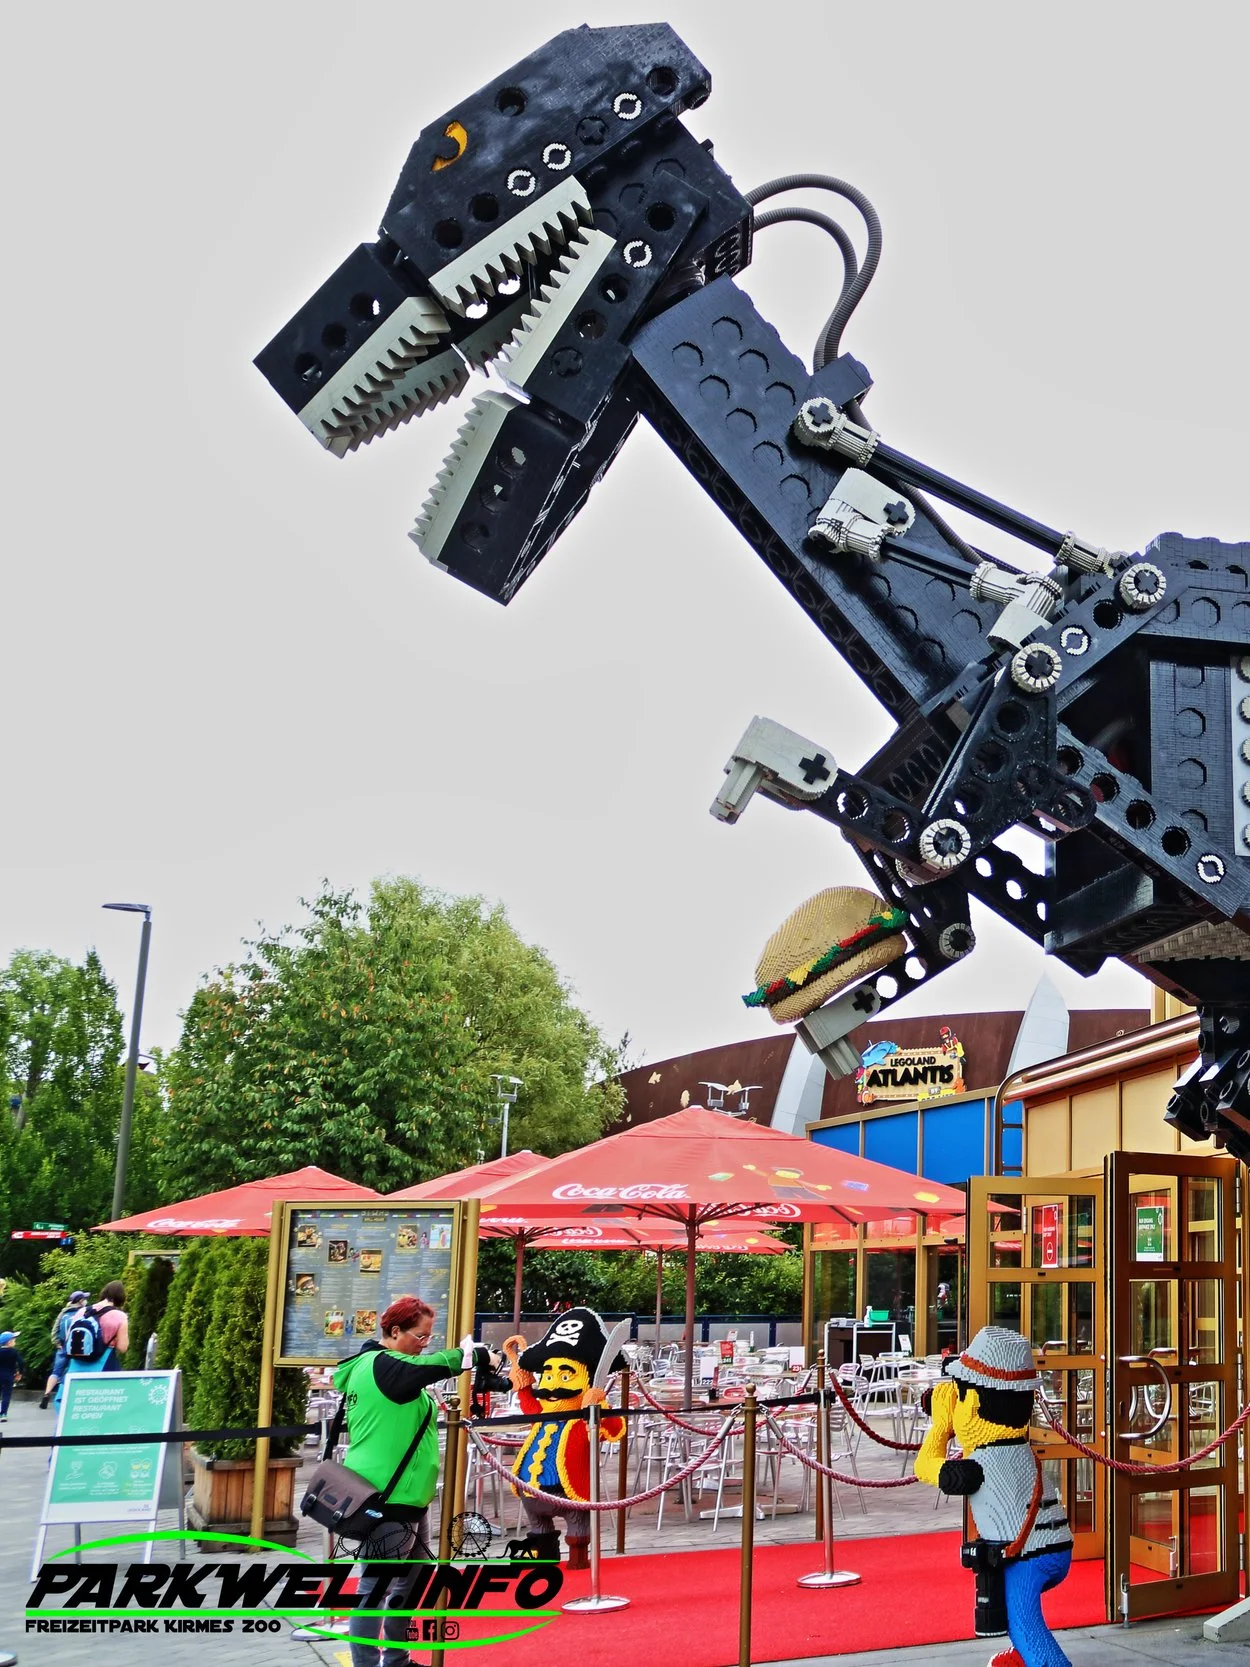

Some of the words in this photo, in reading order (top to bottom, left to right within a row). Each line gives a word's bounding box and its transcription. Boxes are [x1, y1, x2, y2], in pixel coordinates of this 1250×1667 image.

[890, 1056, 937, 1067] LEGOLAND
[866, 1064, 954, 1088] ATLANTIS
[552, 1183, 691, 1200] Coca-Cola
[75, 1388, 125, 1396] RESTAURANT
[72, 1404, 122, 1412] RESTAURANT
[81, 1412, 104, 1420] OPEN
